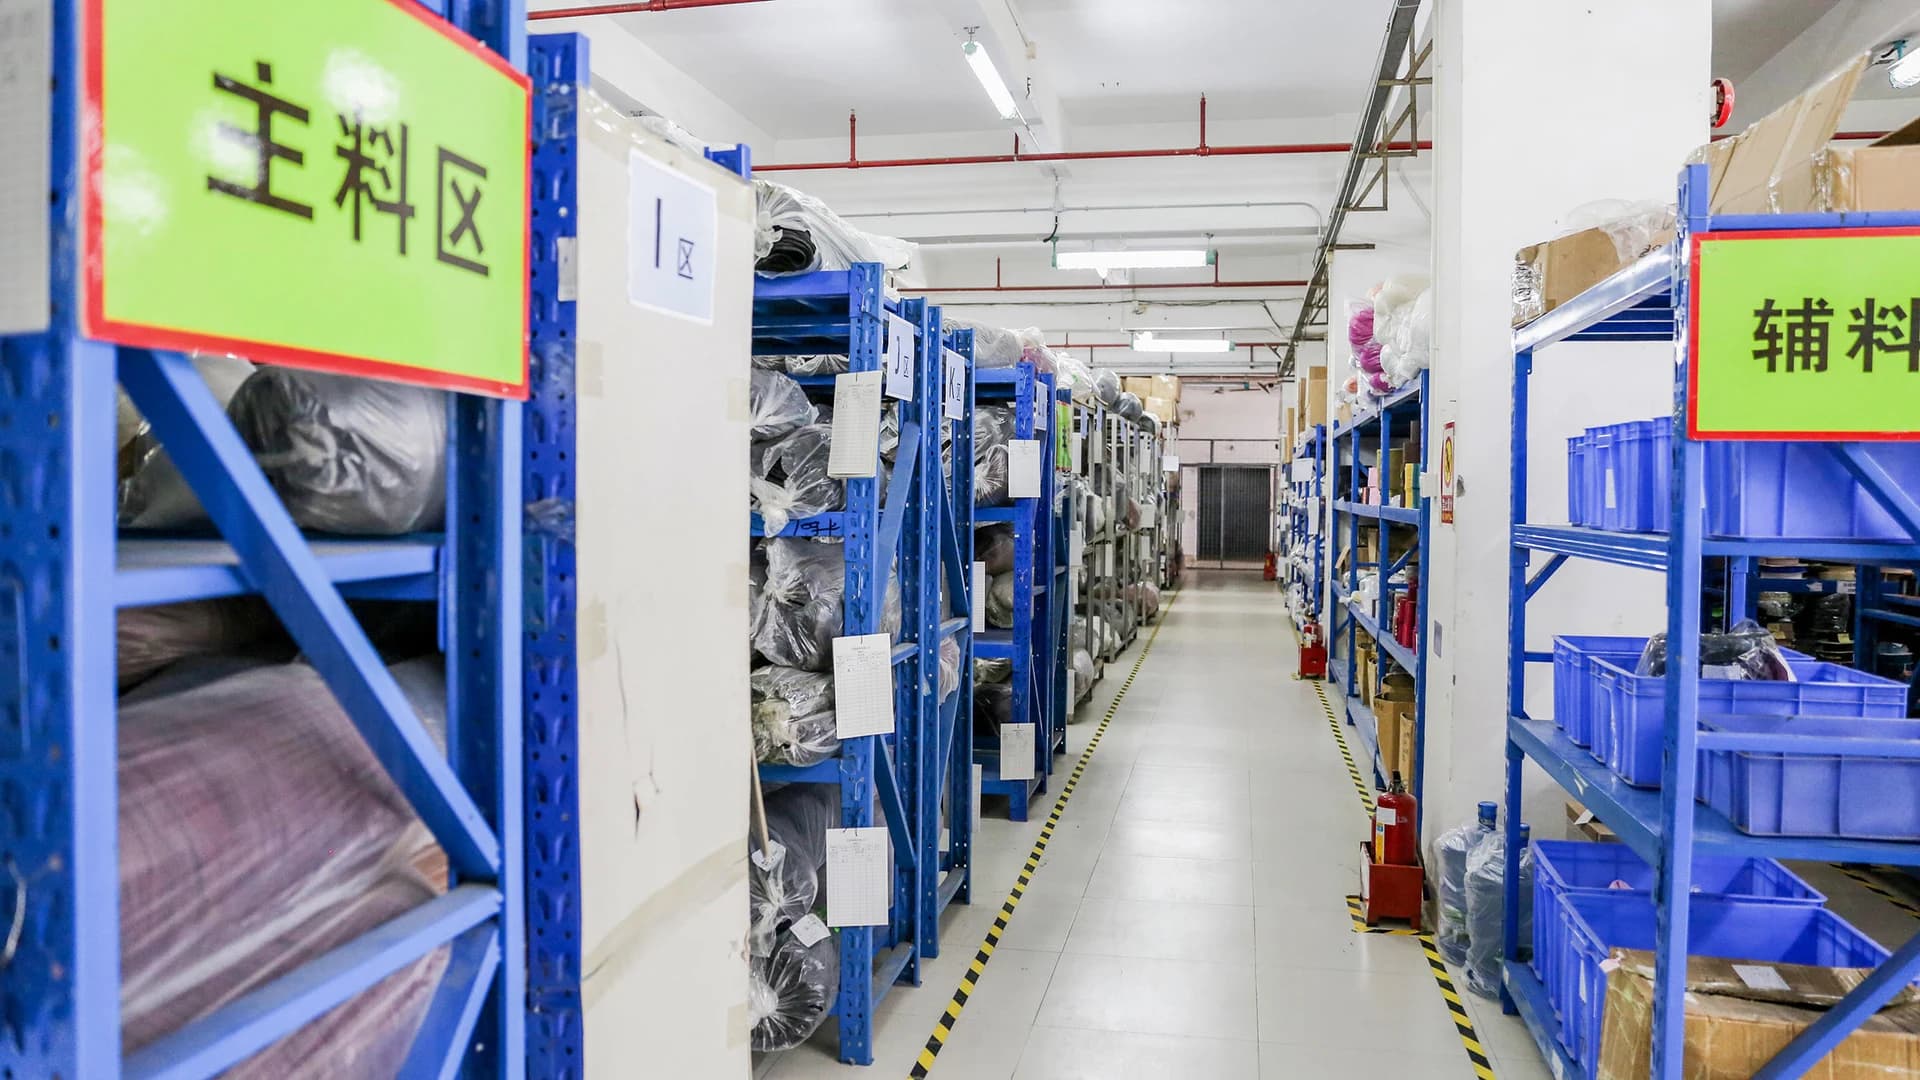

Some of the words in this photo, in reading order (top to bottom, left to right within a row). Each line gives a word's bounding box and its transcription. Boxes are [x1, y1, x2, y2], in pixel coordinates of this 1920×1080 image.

[207, 61, 489, 277] 主料区
[1752, 297, 1920, 373] 辅料
